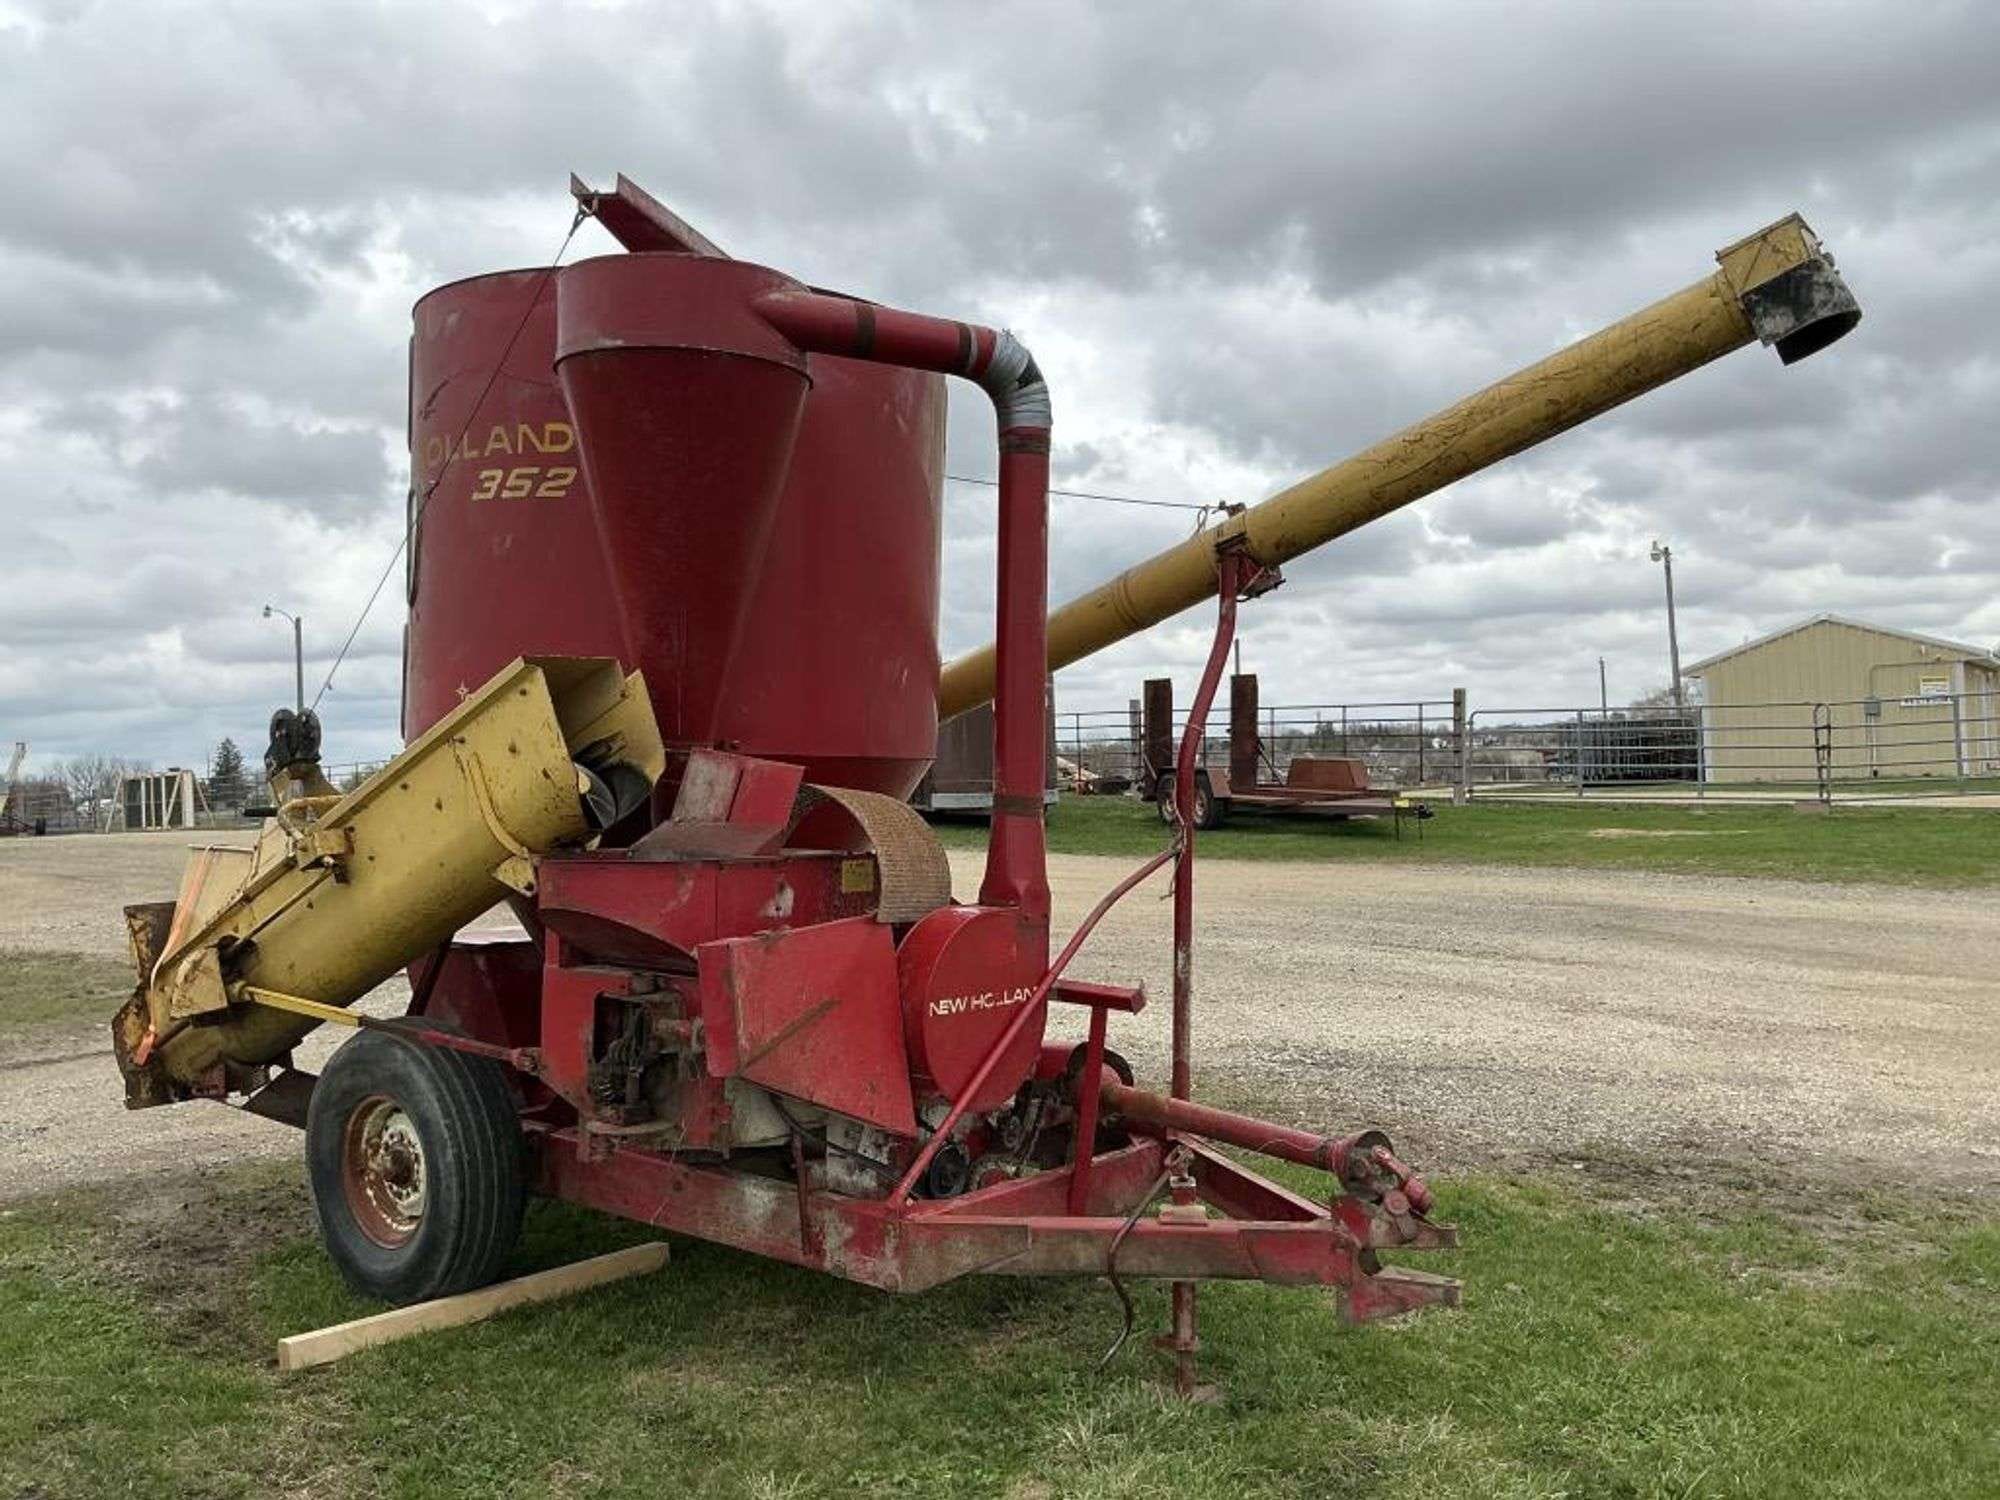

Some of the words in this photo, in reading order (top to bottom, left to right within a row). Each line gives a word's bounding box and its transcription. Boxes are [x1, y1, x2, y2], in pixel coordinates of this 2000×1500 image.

[471, 466, 577, 501] 352
[929, 997, 967, 1017] NEW
[970, 986, 1038, 1010] HOLAN
